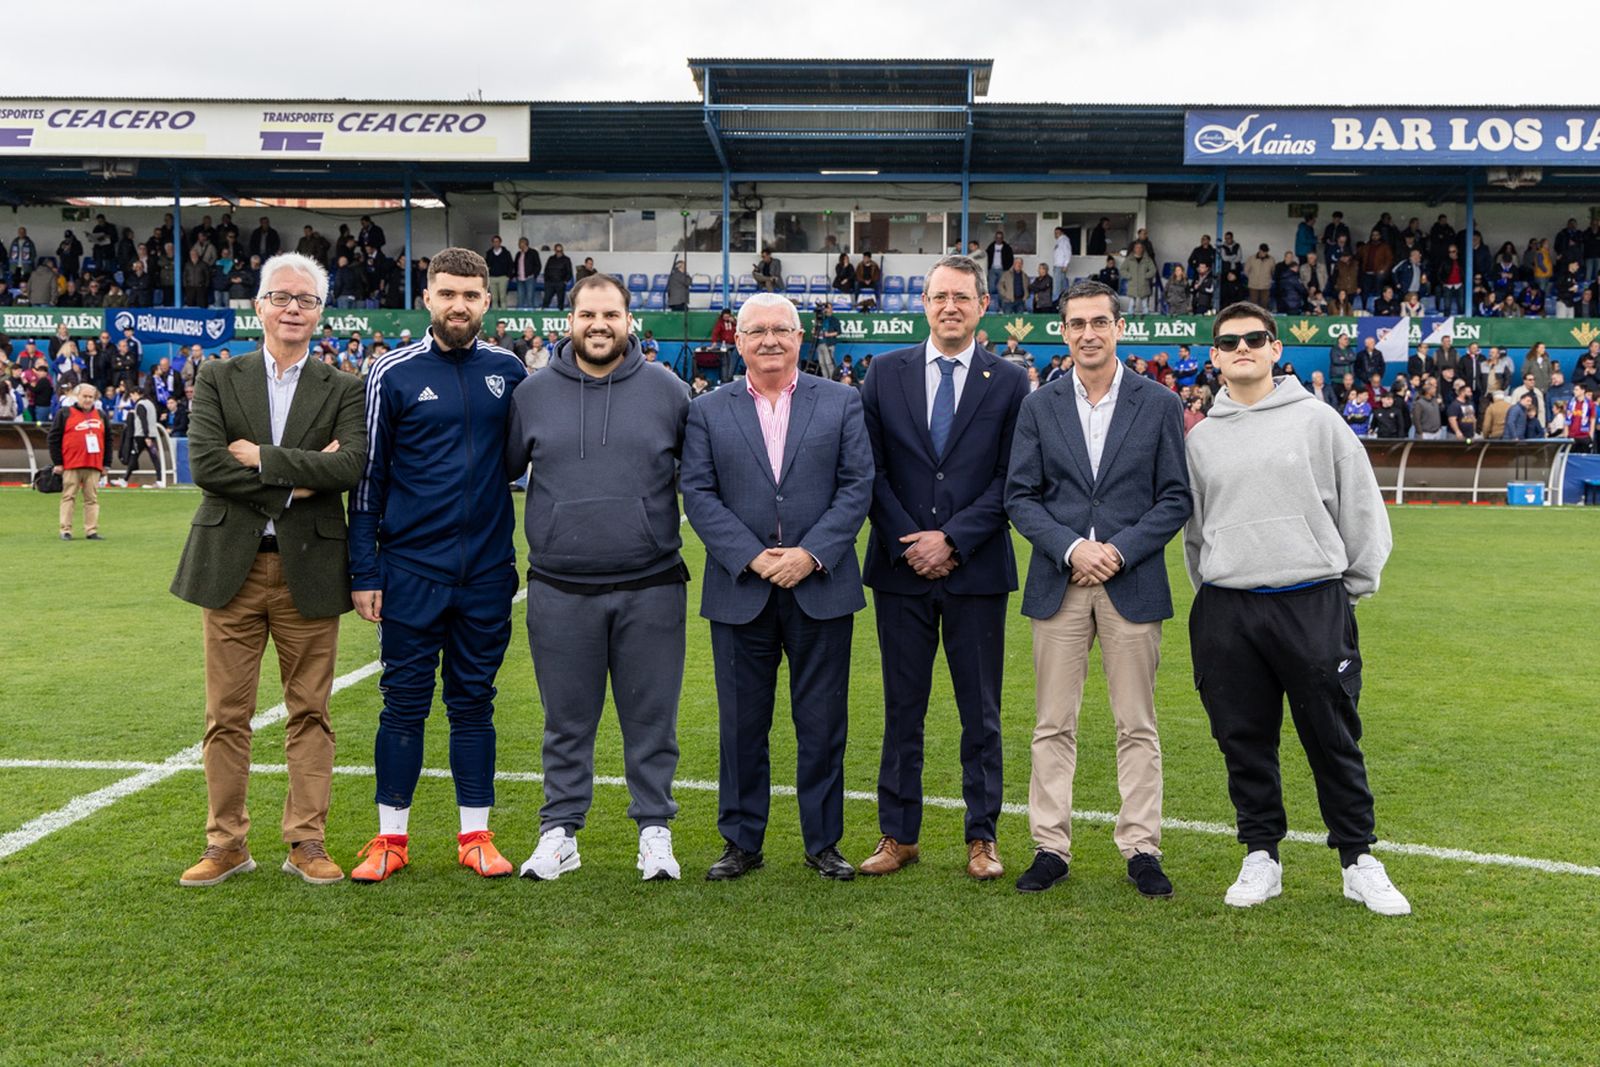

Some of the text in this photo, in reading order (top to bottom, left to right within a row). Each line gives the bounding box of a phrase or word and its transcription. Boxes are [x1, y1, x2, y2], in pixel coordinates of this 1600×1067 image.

[47, 108, 196, 130] CEACERO
[263, 112, 334, 123] TRANSPORTES
[337, 112, 487, 133] CEACERO
[1331, 117, 1437, 151] BAR
[1449, 118, 1543, 152] LOS
[3, 313, 102, 329] RURAL JAÉN
[233, 315, 263, 330] AJA
[872, 318, 914, 335] JAÉN
[1154, 320, 1197, 337] JAÉN
